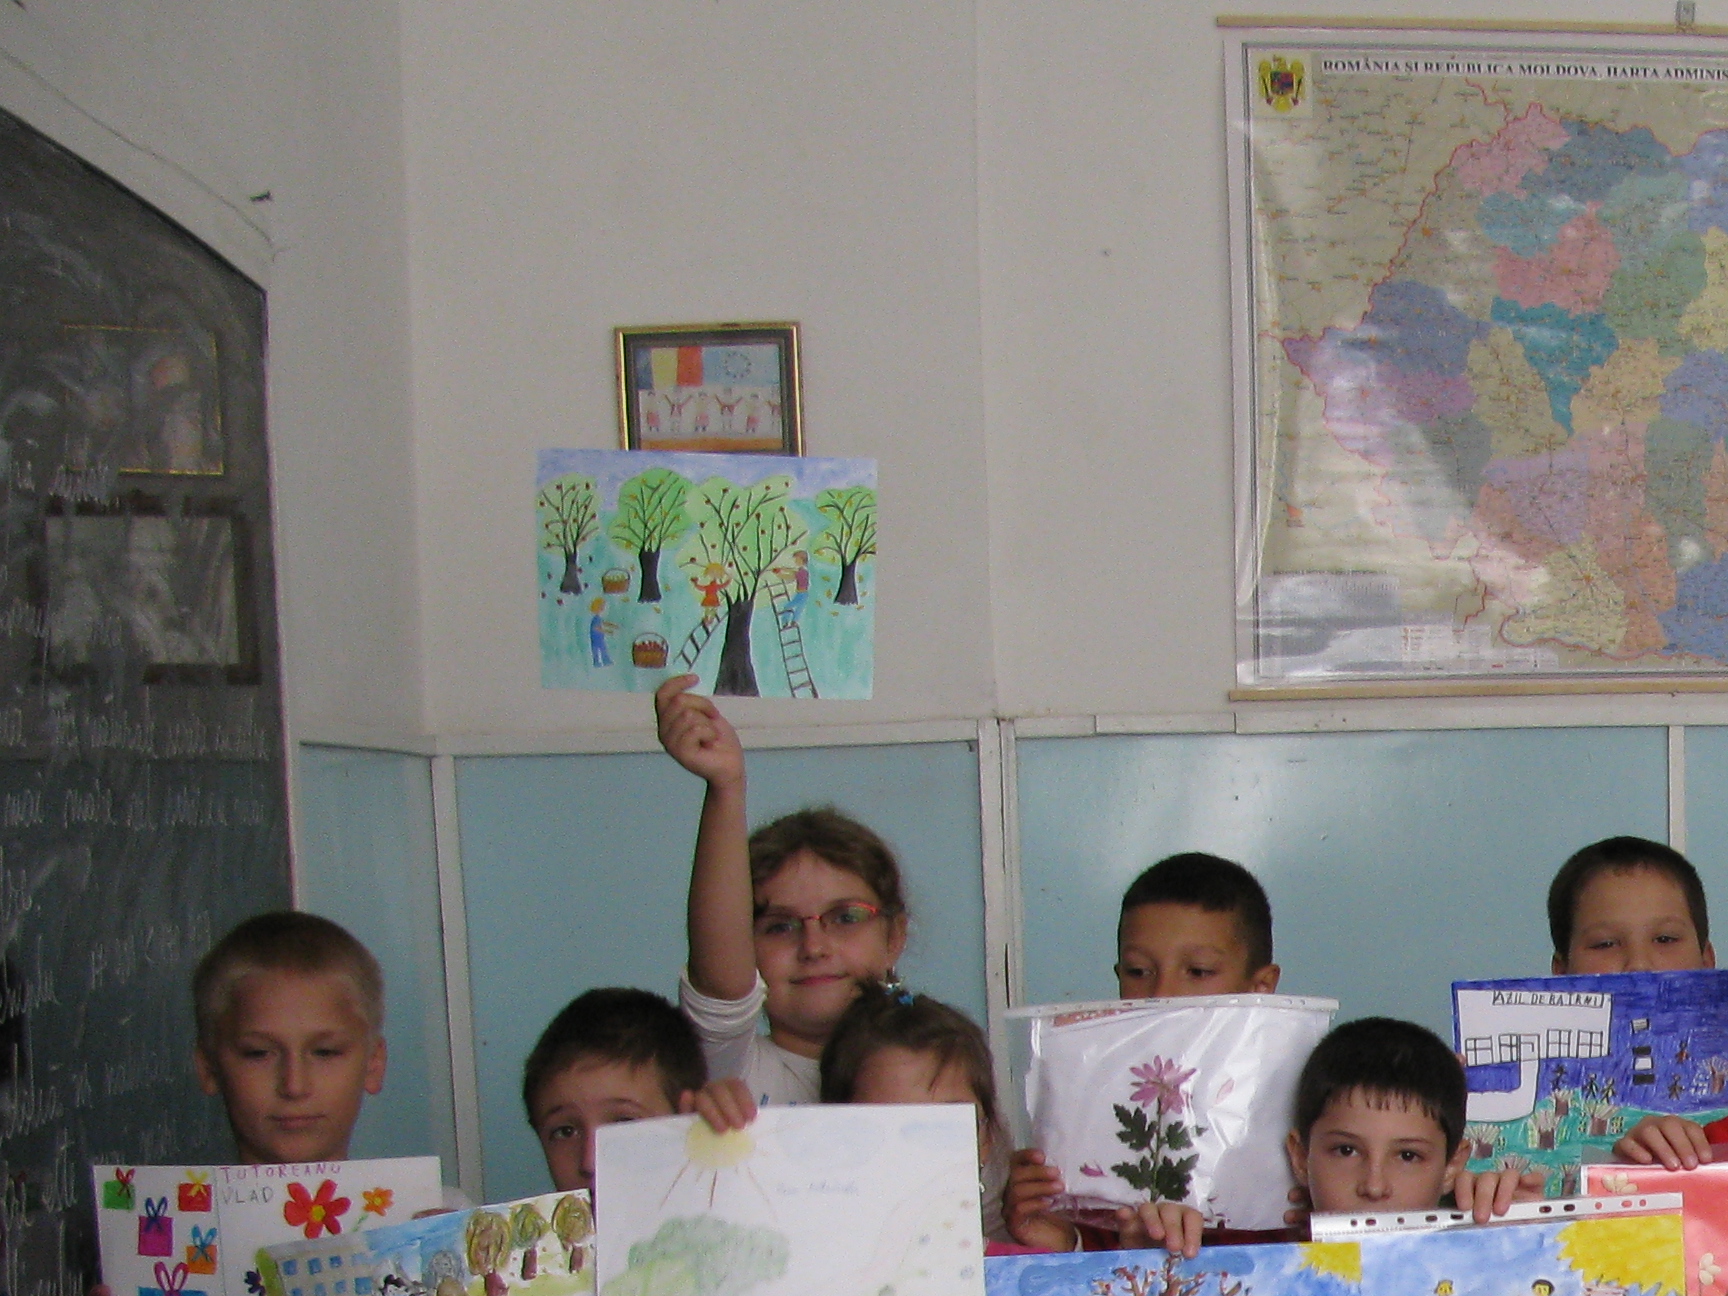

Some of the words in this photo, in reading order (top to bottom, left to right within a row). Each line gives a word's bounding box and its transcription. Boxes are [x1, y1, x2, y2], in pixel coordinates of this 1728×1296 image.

[1423, 62, 1514, 75] REPUBLICA
[1606, 66, 1659, 79] HARTA
[1531, 992, 1545, 1005] DE
[220, 1163, 341, 1184] TUTOREANU
[222, 1186, 274, 1205] VLAD
